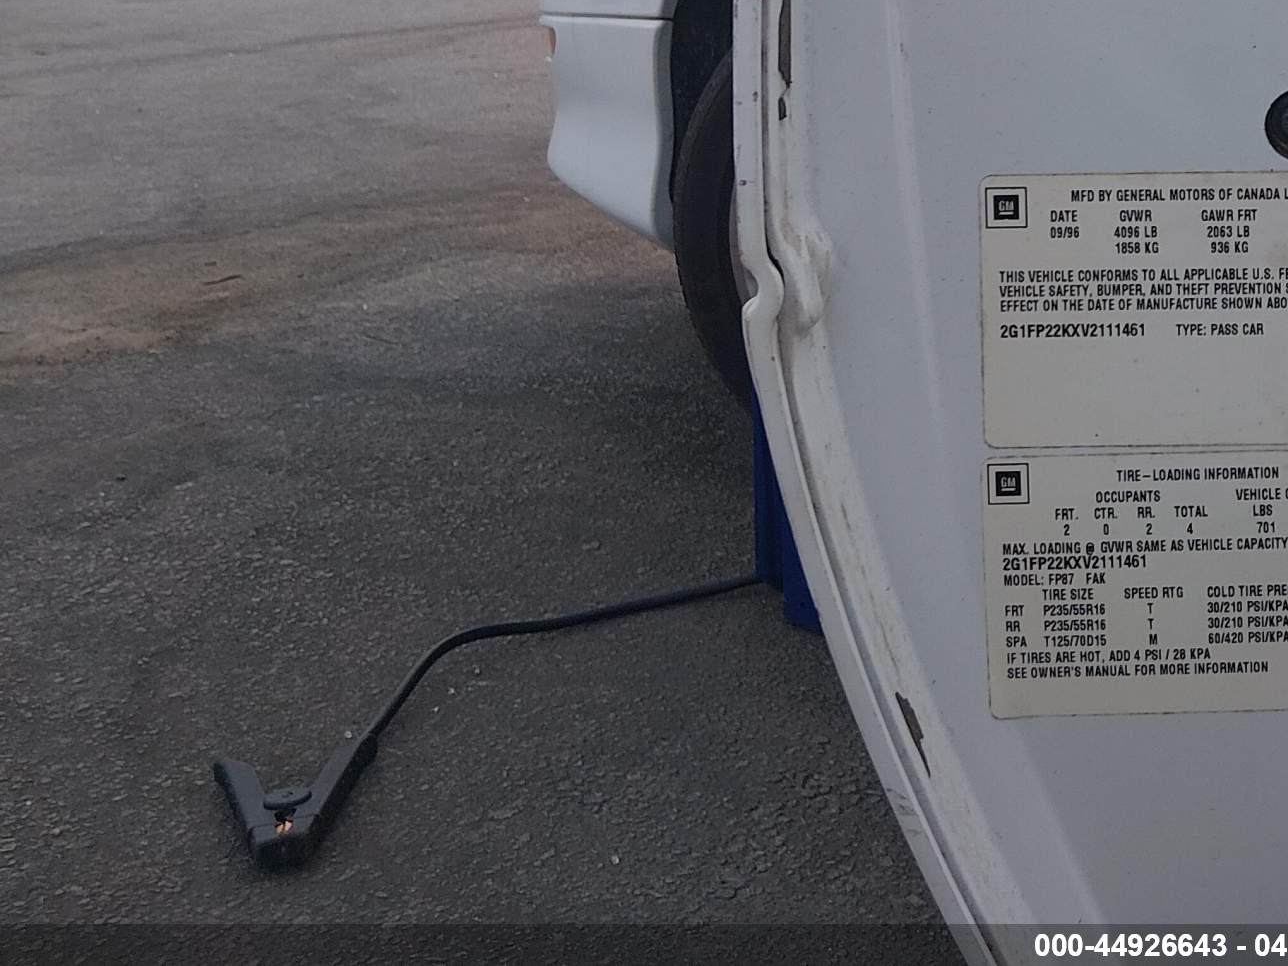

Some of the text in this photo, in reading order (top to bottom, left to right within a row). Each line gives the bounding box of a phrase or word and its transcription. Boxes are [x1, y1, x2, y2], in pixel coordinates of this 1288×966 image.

[1071, 190, 1094, 202] MFD
[1098, 190, 1112, 201] BY
[1116, 189, 1165, 201] GENERAL
[1170, 188, 1215, 201] MOTORS
[1218, 188, 1232, 200] OF
[1237, 188, 1280, 200] CANADA
[1050, 210, 1077, 222] DATE
[1119, 210, 1152, 222] GVWR
[1201, 209, 1234, 221] GAWR
[1238, 209, 1257, 221] FRT
[1050, 226, 1079, 238] 09/96
[1114, 226, 1140, 238] 4096
[1144, 226, 1157, 238] LB
[1207, 226, 1233, 238] 2063
[1237, 226, 1250, 238] LB
[999, 271, 1025, 283] THIS
[1028, 270, 1073, 283] VEHICLE
[1078, 269, 1138, 282] CONFORMS
[1142, 269, 1155, 281] TO
[1160, 269, 1180, 281] ALL
[1183, 268, 1248, 281] APPLICABLE
[1252, 268, 1274, 280] U.S.
[999, 285, 1045, 297] VEHICLE
[1049, 284, 1092, 297] SAFETY,
[1097, 284, 1146, 297] BUMPER,
[1150, 283, 1172, 295] AND
[1176, 283, 1209, 295] THEFT
[1214, 282, 1281, 295] PREVENTION
[1000, 300, 1039, 312] EFFECT
[1043, 299, 1058, 311] ON
[1062, 299, 1083, 311] THE
[1088, 298, 1114, 311] DATE
[1118, 298, 1132, 310] OF
[1136, 297, 1217, 310] MANUFACTURE
[1221, 297, 1262, 309] SHOWN
[1000, 323, 1144, 338] 2G1FP22KXV2111461
[1176, 323, 1264, 336] TYPE: PASS CAR
[1204, 466, 1279, 480] INFORMATION
[1096, 490, 1160, 503] OCCUPANTS
[1235, 488, 1281, 501] VEHICLE
[1055, 508, 1078, 520] FRT.
[1094, 507, 1117, 519] CTR.
[1137, 506, 1155, 518] RR.
[1174, 505, 1208, 517] TOTAL
[1253, 504, 1273, 516] LBS
[1003, 543, 1029, 555] MAX.
[1034, 542, 1081, 555] LOADING
[1086, 542, 1095, 555] @
[1100, 541, 1133, 553] GVWR
[1136, 540, 1166, 552] SAME
[1170, 539, 1184, 551] AS
[1187, 538, 1232, 551] VEHICLE
[1237, 537, 1288, 550] CAPACITY
[1003, 555, 1147, 570] 2G1FP22KXV2111461
[1004, 572, 1106, 586] MODEL: FP87 FAK
[1042, 589, 1066, 601] TIRE
[1070, 588, 1094, 601] SIZE
[1124, 587, 1158, 599] SPEED
[1162, 586, 1183, 598] RTG
[1207, 585, 1235, 598] COLD
[1238, 585, 1263, 597] TIRE
[1006, 636, 1027, 648] SPA
[1044, 634, 1107, 647] T125/70D15
[1149, 634, 1158, 645] M
[1208, 632, 1243, 644] 60/420
[1007, 661, 1268, 679] SEE OWNER'S MANUAL FOR MORE INFORMATION
